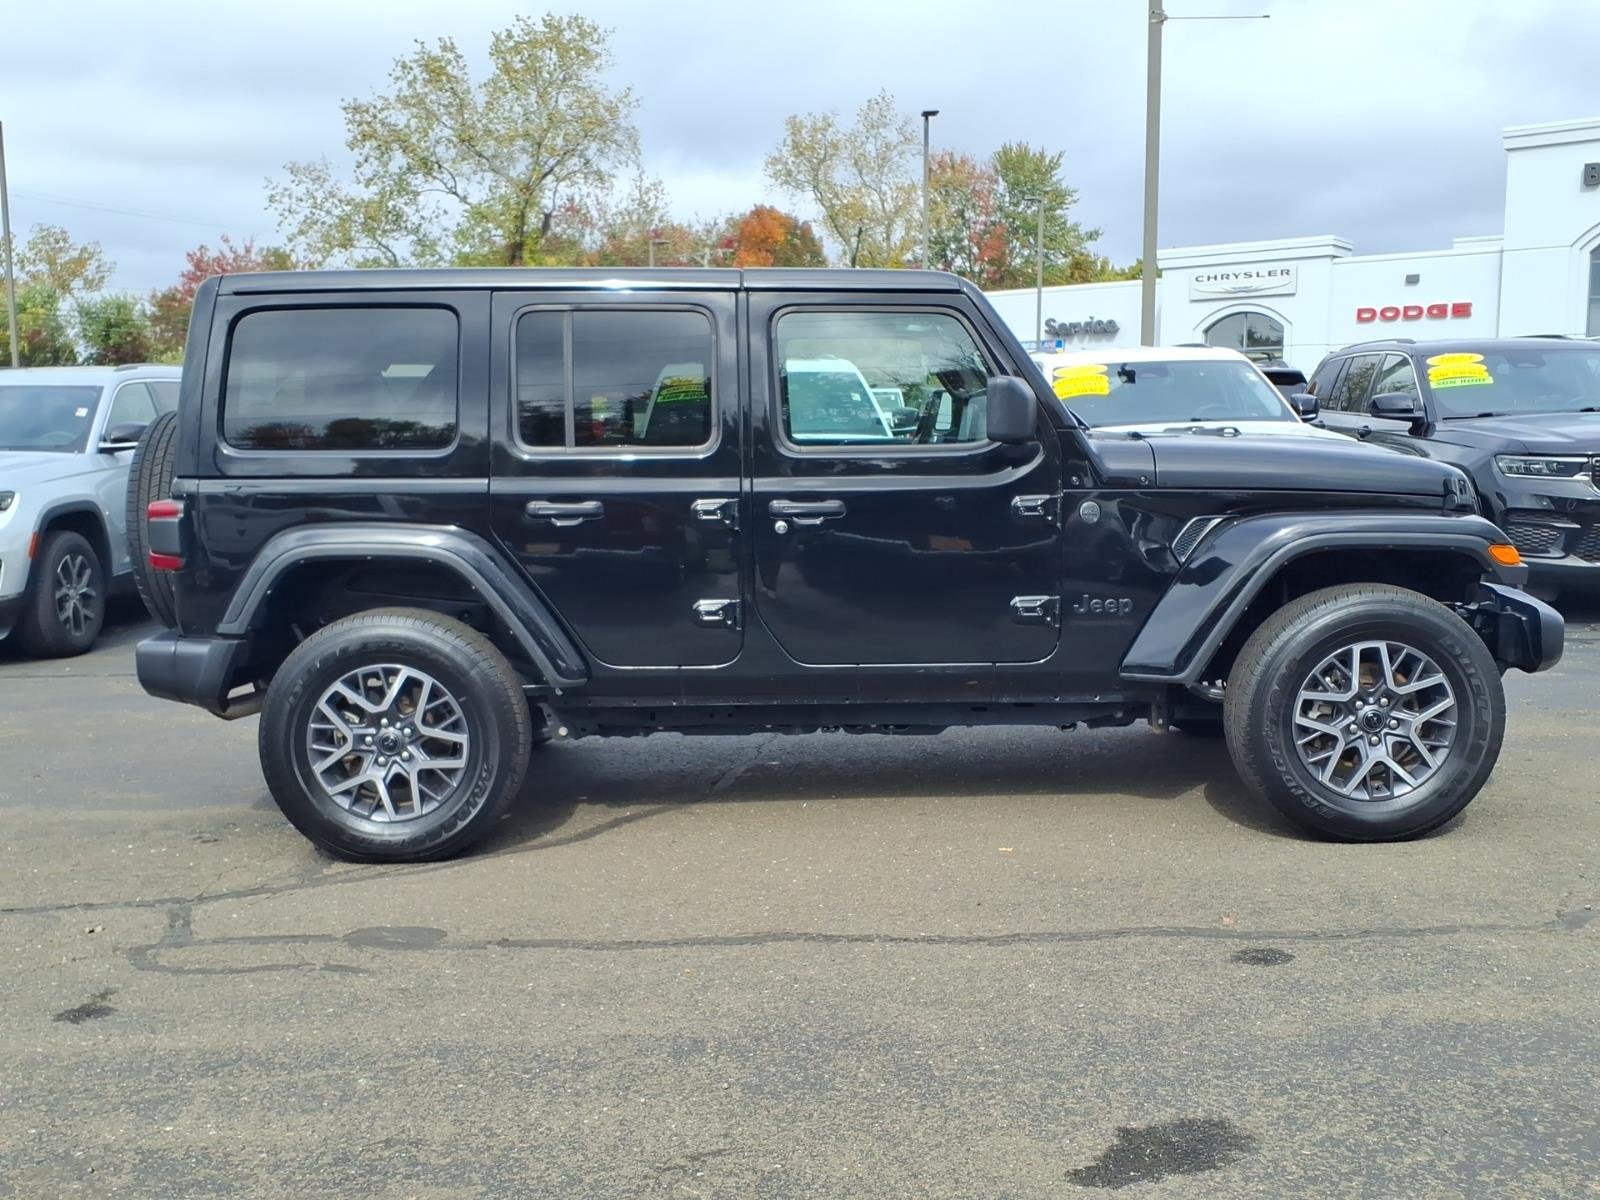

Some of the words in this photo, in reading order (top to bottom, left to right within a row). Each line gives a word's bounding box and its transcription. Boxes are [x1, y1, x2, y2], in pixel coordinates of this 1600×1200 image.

[1195, 269, 1291, 282] CHRYSLER
[1357, 302, 1472, 323] DODGE
[1044, 316, 1120, 336] Service
[1073, 594, 1133, 616] Jeep
